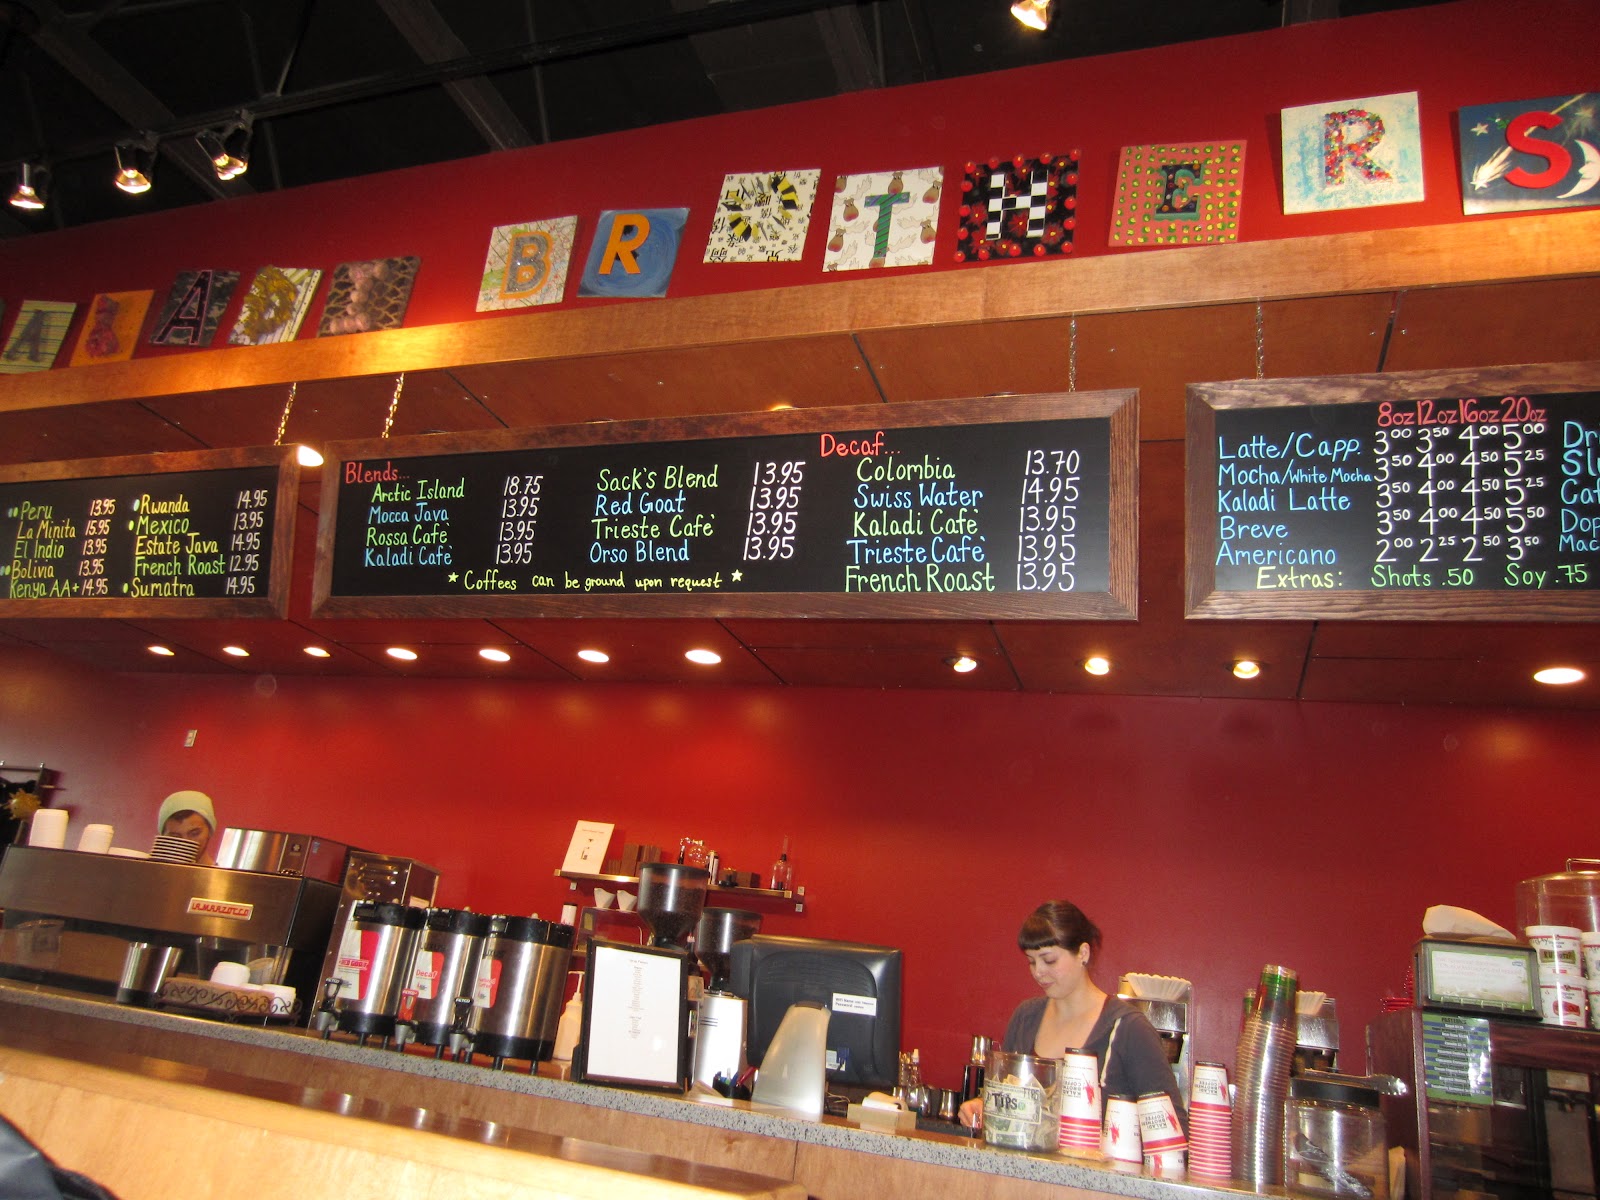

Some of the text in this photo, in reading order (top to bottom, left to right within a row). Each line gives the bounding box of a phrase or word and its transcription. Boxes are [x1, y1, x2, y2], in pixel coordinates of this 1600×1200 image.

[1378, 397, 1547, 427] 8oz 12oz 16oz 20oz
[1564, 421, 1600, 448] Dr
[664, 464, 718, 490] Blend
[754, 462, 806, 486] 13.95
[856, 450, 1080, 482] Colombia 13.70
[1330, 468, 1372, 483] Mocha
[140, 490, 268, 514] Rwanda 14.95
[371, 476, 544, 503] Arctic Island 18.75
[596, 486, 802, 517] Red Goat 13.95
[854, 477, 1081, 509] Swiss Water 14.95
[1218, 488, 1276, 513] Kaladi
[1289, 487, 1351, 511] Latte
[21, 499, 116, 520] Peru 13.95
[368, 496, 540, 524] Mocca Java 13.95
[854, 509, 923, 537] Kaladi
[1020, 506, 1076, 533] 13.95
[17, 520, 111, 539] La Minita 15.95
[136, 512, 264, 535] Mexico 13.95
[366, 526, 408, 547] Rossa
[500, 520, 537, 542] 13.95
[592, 516, 661, 540] Trieste
[748, 511, 799, 536] 13.95
[1220, 516, 1289, 540] Breve
[14, 539, 108, 559] El Indio 13.95
[136, 532, 261, 556] Estate Java 14.95
[364, 546, 413, 567] Kaladi
[496, 542, 533, 564] 13.95
[590, 536, 795, 563] Orso Blend 13.95
[846, 538, 927, 565] Trieste
[1018, 534, 1076, 562] 13.95
[1216, 541, 1336, 566] Americano
[12, 559, 104, 579] Bolivia 13.95
[134, 554, 260, 576] French Roast 12.95
[845, 562, 1075, 593] French Roast 13.95
[1371, 564, 1432, 587] Shots
[1504, 563, 1547, 589] Soy
[10, 580, 46, 599] Kenya
[81, 578, 108, 596] 14.95
[130, 576, 255, 597] Sumatra 14.95
[464, 569, 723, 591] Coffees can be ground upon request
[992, 1092, 1018, 1110] TIPS
